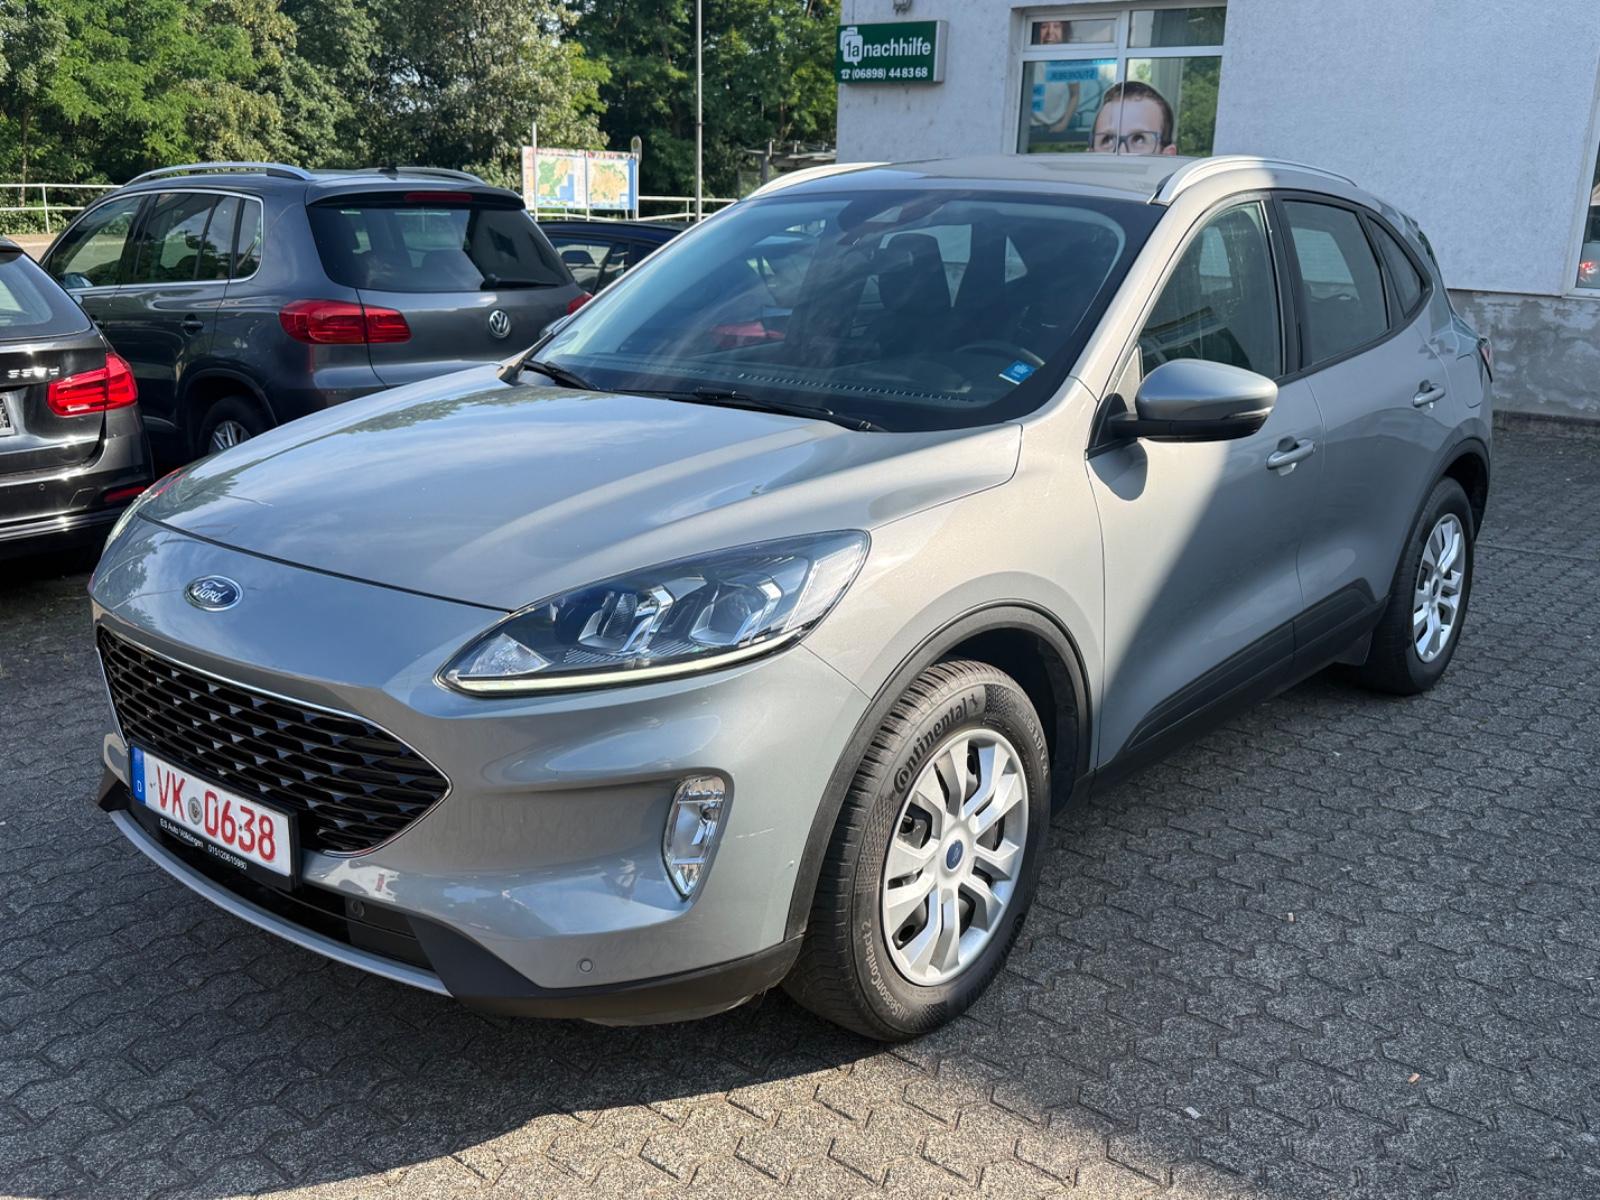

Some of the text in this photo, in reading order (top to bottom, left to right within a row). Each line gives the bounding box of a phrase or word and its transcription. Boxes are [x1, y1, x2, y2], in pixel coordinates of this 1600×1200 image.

[193, 580, 229, 603] Ford
[893, 696, 968, 794] Continental
[136, 779, 143, 793] D
[156, 764, 277, 862] VK 0638
